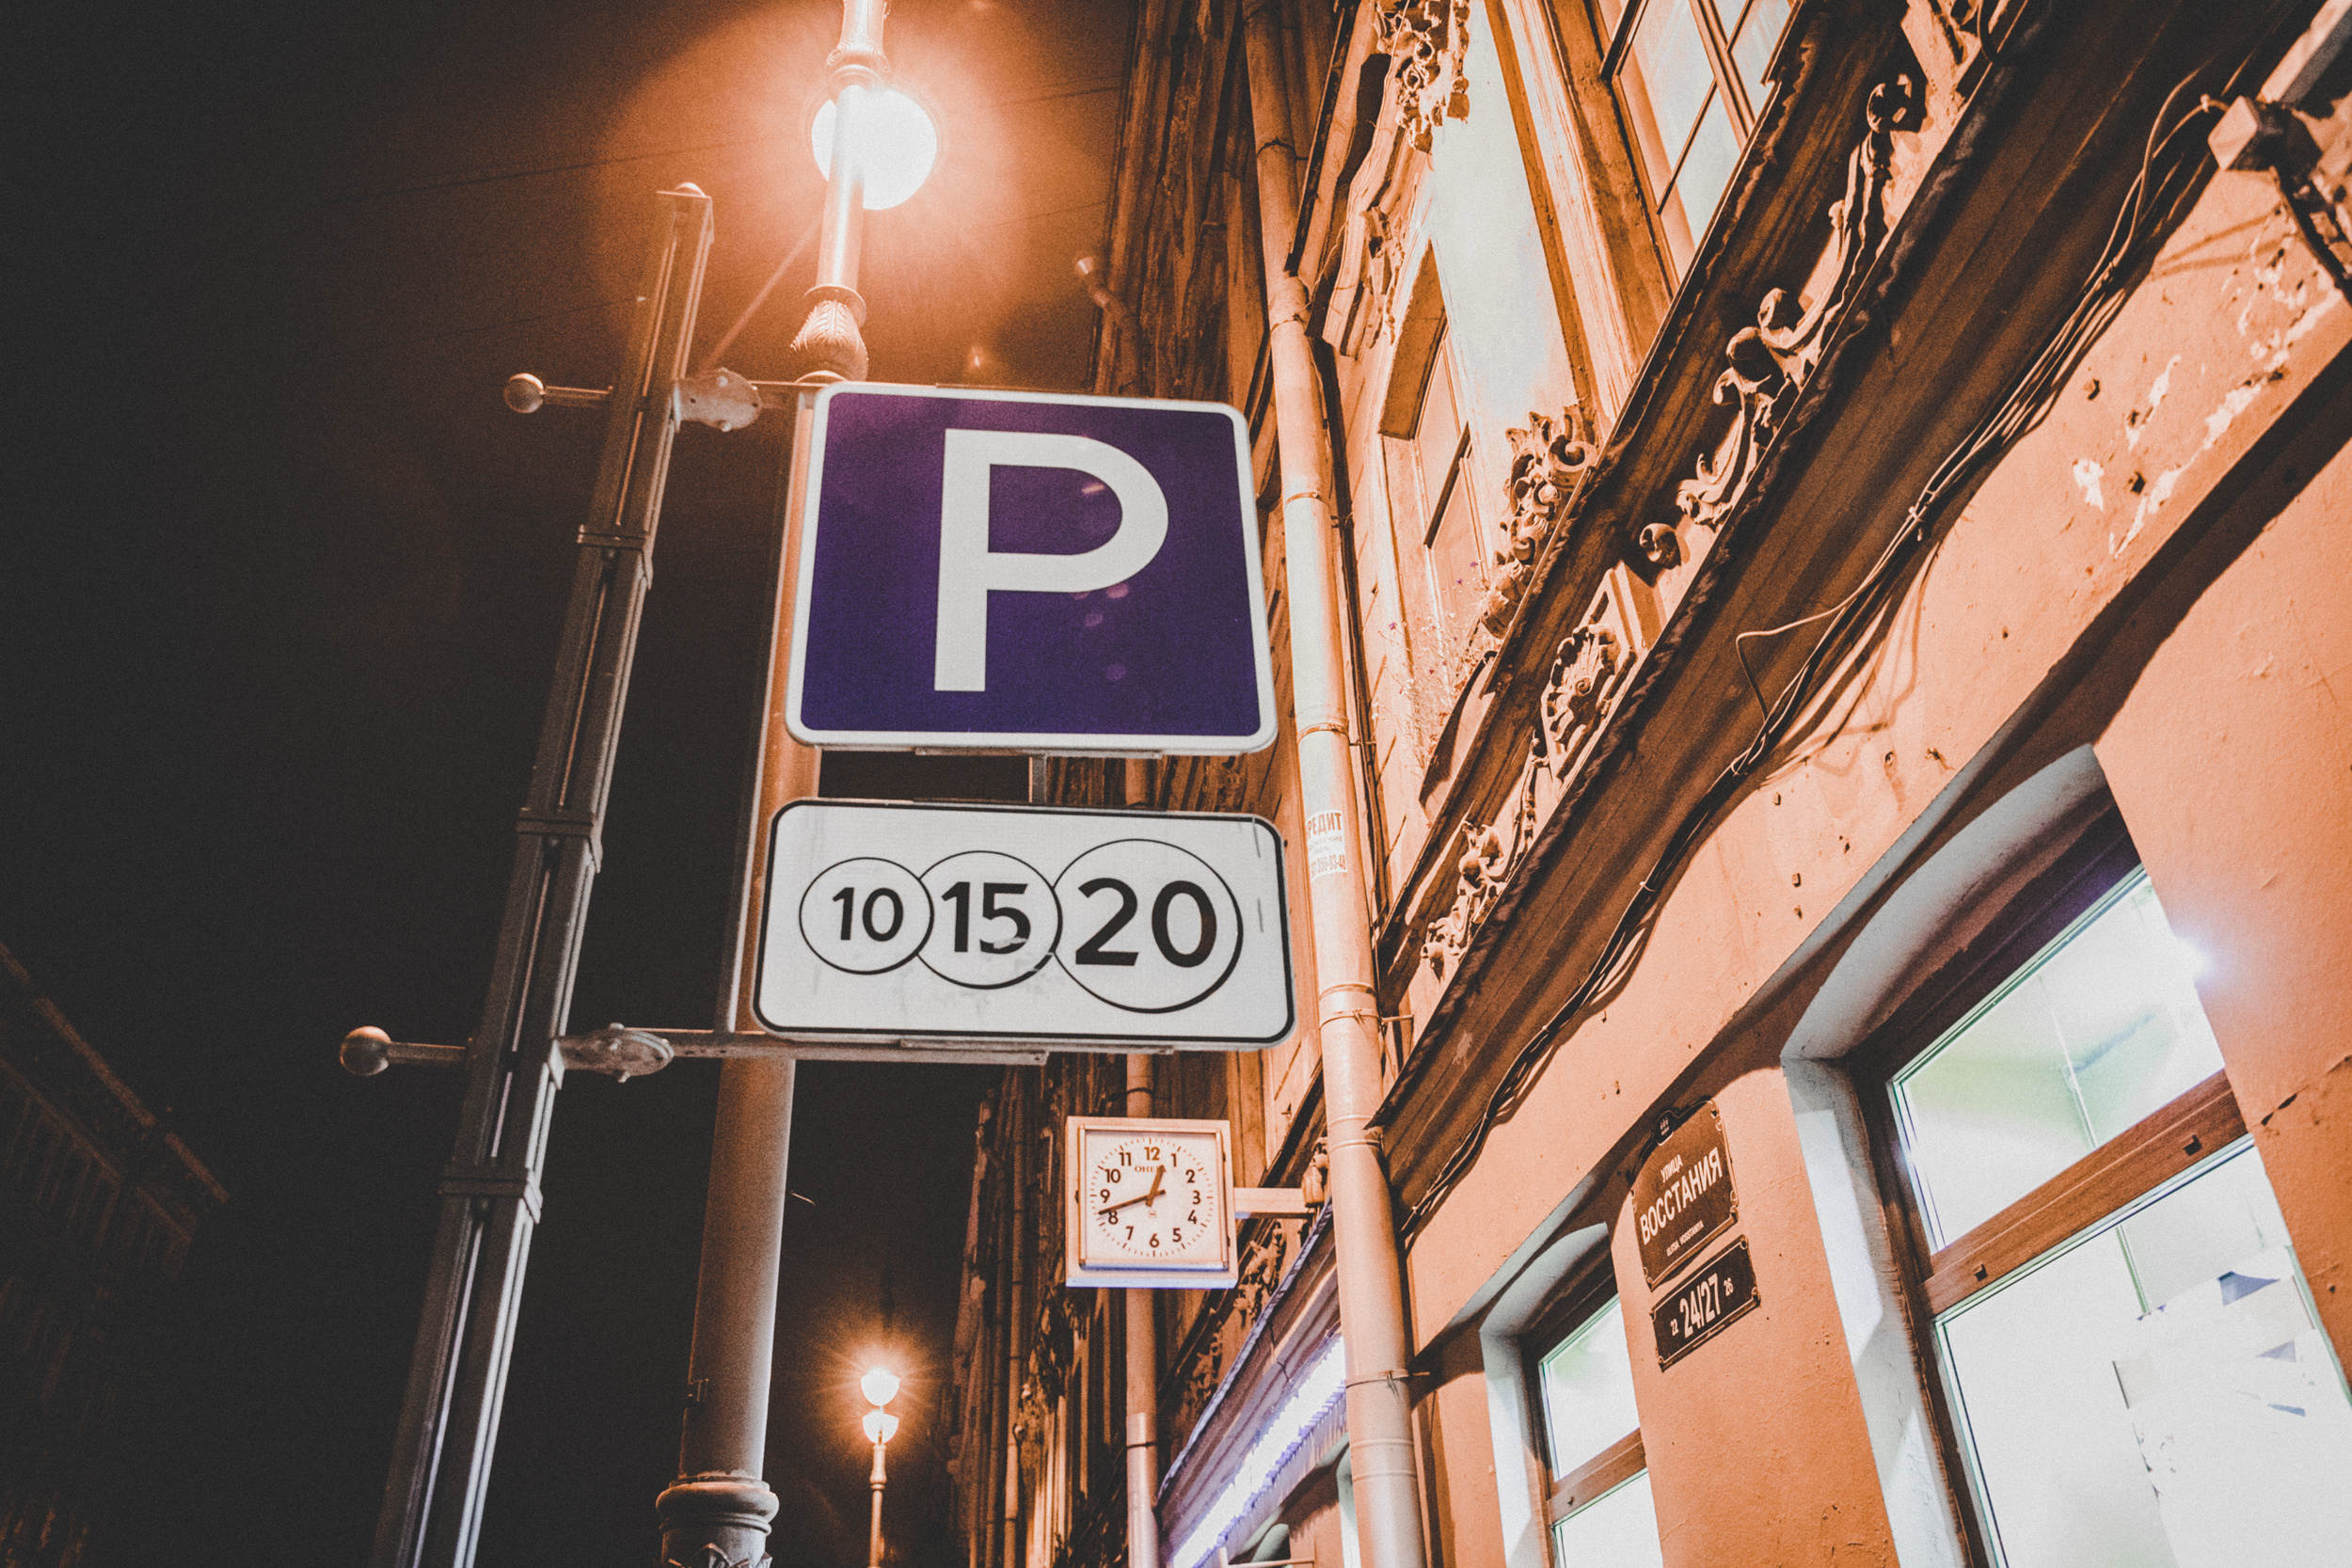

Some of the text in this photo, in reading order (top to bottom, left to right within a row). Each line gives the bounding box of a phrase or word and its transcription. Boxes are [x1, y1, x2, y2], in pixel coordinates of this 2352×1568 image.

[934, 428, 1169, 692] P
[1306, 813, 1342, 838] РЕДИТ
[832, 877, 1217, 968] 10 15 20
[1119, 1152, 1132, 1166] 11
[1144, 1147, 1160, 1161] 12
[1170, 1153, 1178, 1167] 1
[1660, 1154, 1683, 1183] УЛИЦА
[1104, 1169, 1121, 1183] 10
[1185, 1169, 1196, 1183] 2
[1100, 1189, 1110, 1203] 9
[1192, 1190, 1201, 1205] 3
[1640, 1147, 1723, 1245] ВОССТАНИЯ
[1108, 1211, 1119, 1225] 8
[1187, 1210, 1198, 1224] 4
[1126, 1226, 1135, 1240] 7
[1172, 1227, 1183, 1242] 5
[1150, 1233, 1160, 1248] 6
[1670, 1273, 1734, 1338] 22 24/27 26
